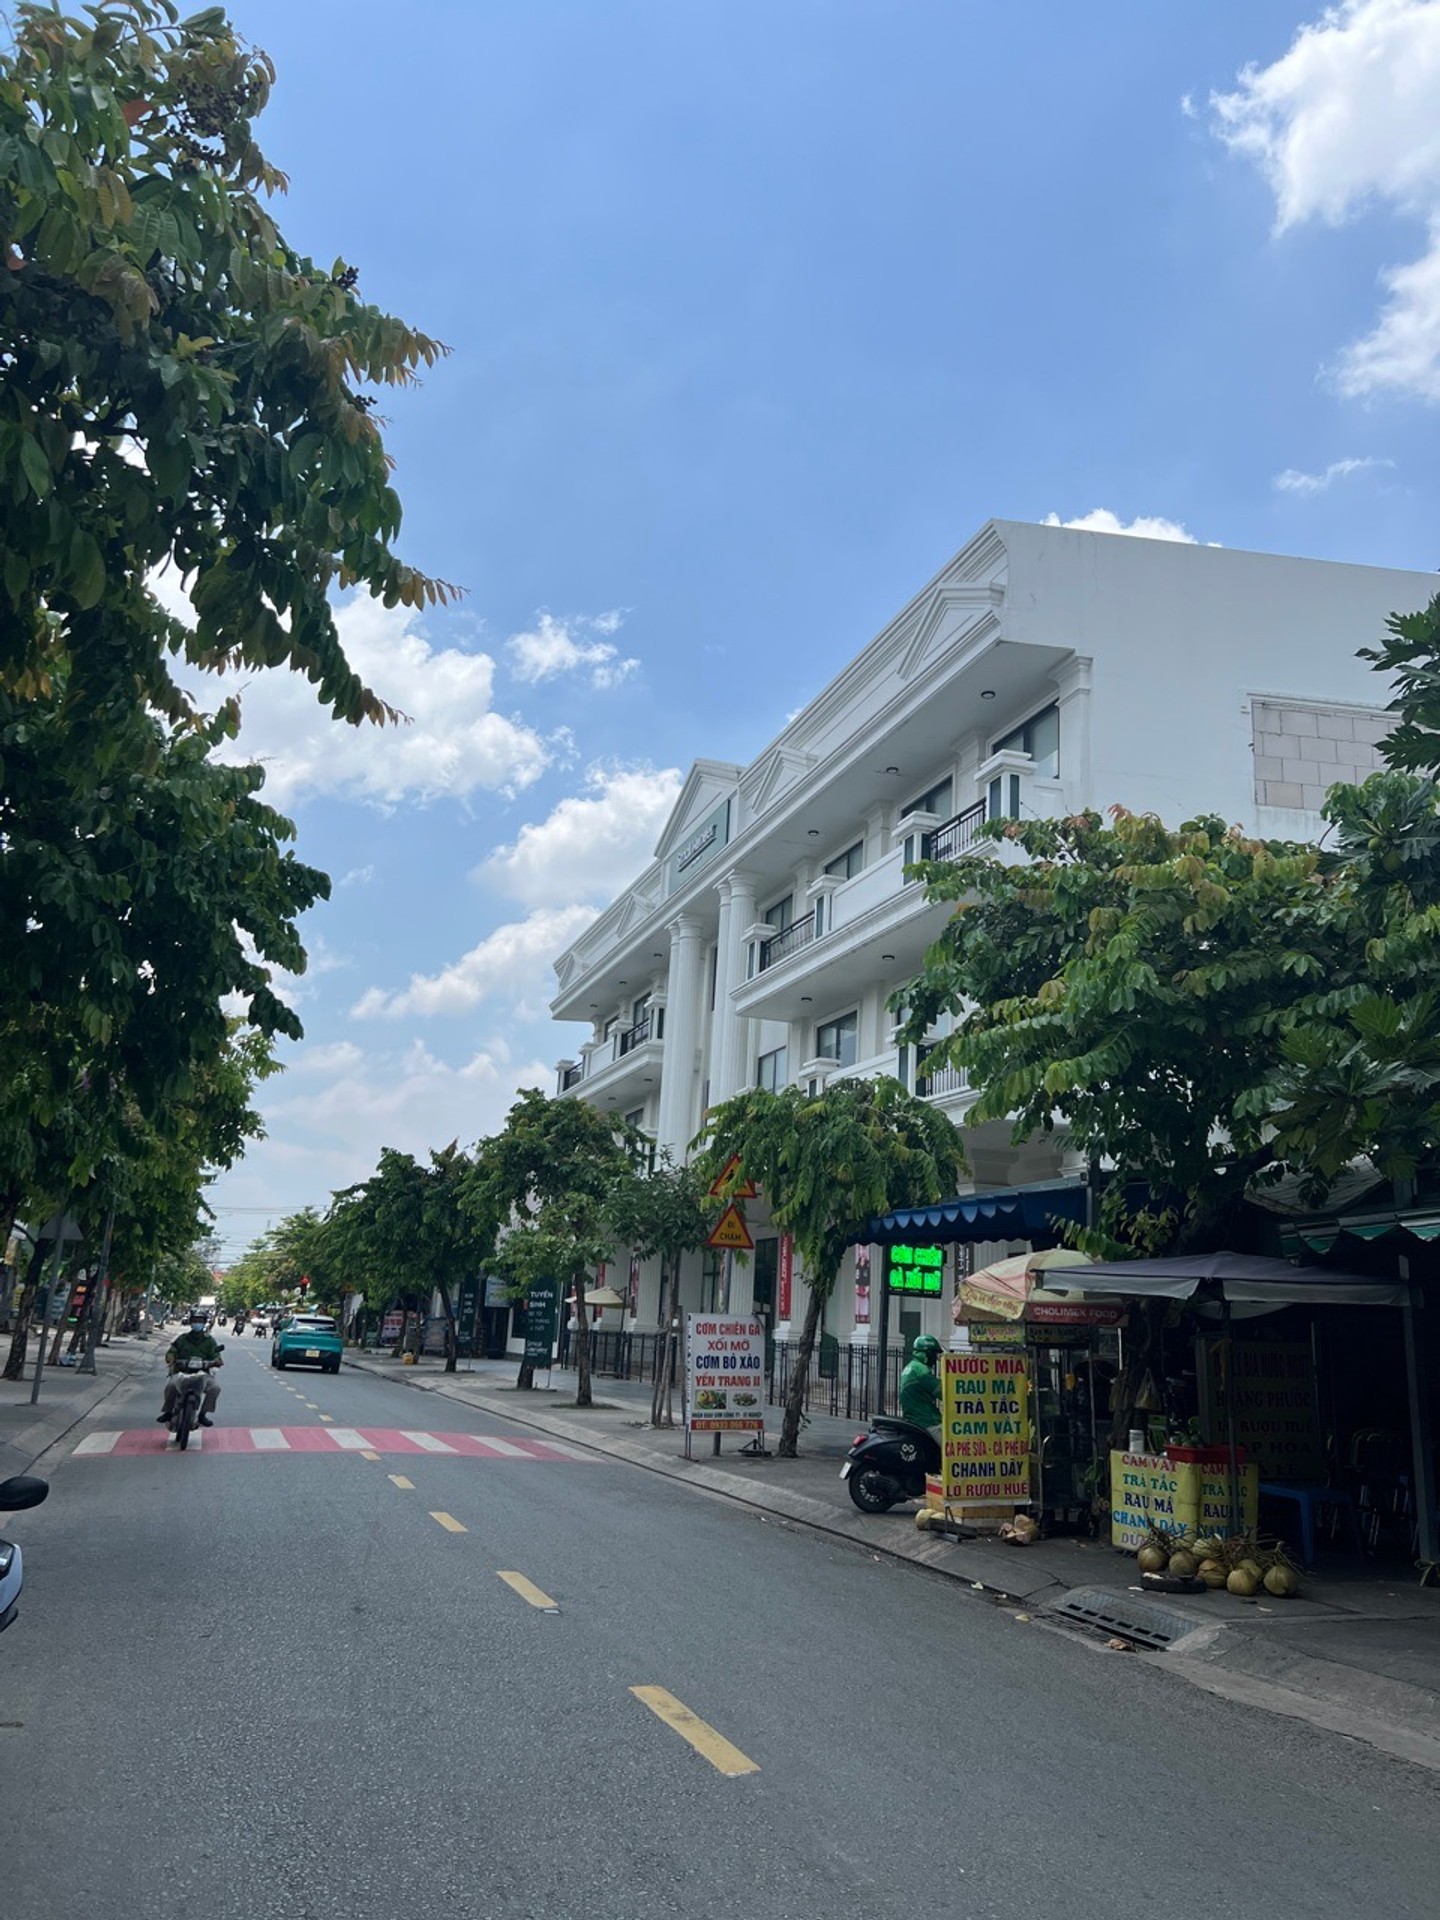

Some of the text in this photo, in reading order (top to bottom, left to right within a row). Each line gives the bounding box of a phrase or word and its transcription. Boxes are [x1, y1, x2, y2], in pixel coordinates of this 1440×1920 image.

[1033, 1306, 1086, 1319] CHOLIMEX
[1089, 1308, 1118, 1320] FOOD
[696, 1321, 761, 1336] CƠM CHIÊN GÀ
[708, 1336, 727, 1351] XỐI
[696, 1354, 720, 1370] CƠM
[723, 1352, 737, 1370] BÒ
[945, 1355, 1025, 1374] NƯỚC MÍA
[695, 1371, 715, 1387] YẾN
[718, 1375, 751, 1387] TRANG
[956, 1376, 1016, 1395] RAU MÁ
[954, 1394, 1020, 1414] TRÀ TẮC
[952, 1415, 1022, 1435] CAM VẮT
[945, 1440, 955, 1457] CÀ
[957, 1439, 971, 1457] PHÊ
[952, 1458, 1023, 1478] CHANH DÂY
[1121, 1453, 1148, 1469] CAM
[946, 1482, 961, 1497] LÒ
[966, 1482, 1000, 1499] RƯỢU
[1122, 1472, 1178, 1492] TRÀ TẮC
[1124, 1492, 1174, 1515] RAU MÁ
[1203, 1503, 1228, 1518] RAU
